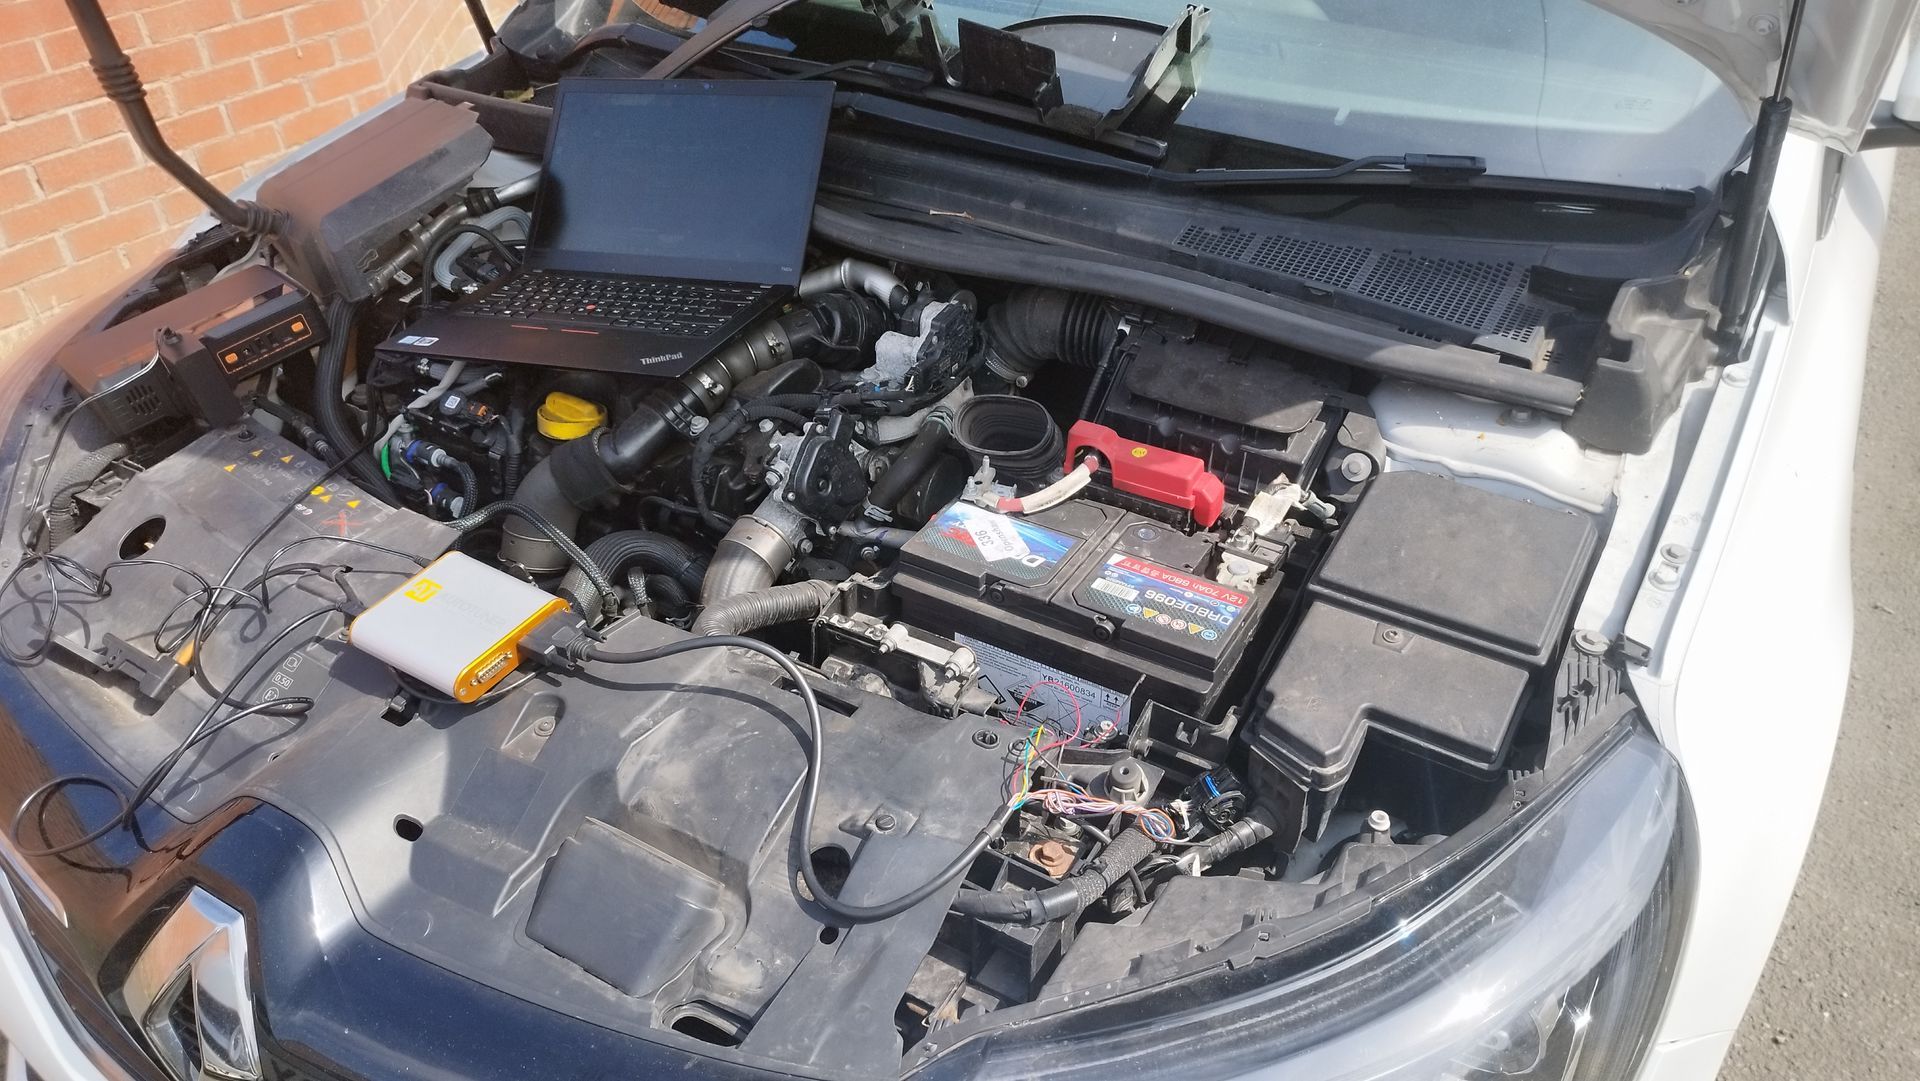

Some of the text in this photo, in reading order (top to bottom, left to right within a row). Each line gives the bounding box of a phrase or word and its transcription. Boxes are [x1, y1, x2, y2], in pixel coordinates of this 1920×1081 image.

[640, 351, 683, 365] ThinkPad
[975, 530, 994, 547] 336
[1191, 581, 1220, 596] 70Ah
[1221, 592, 1244, 605] 12V
[1144, 589, 1234, 626] DRBDE096
